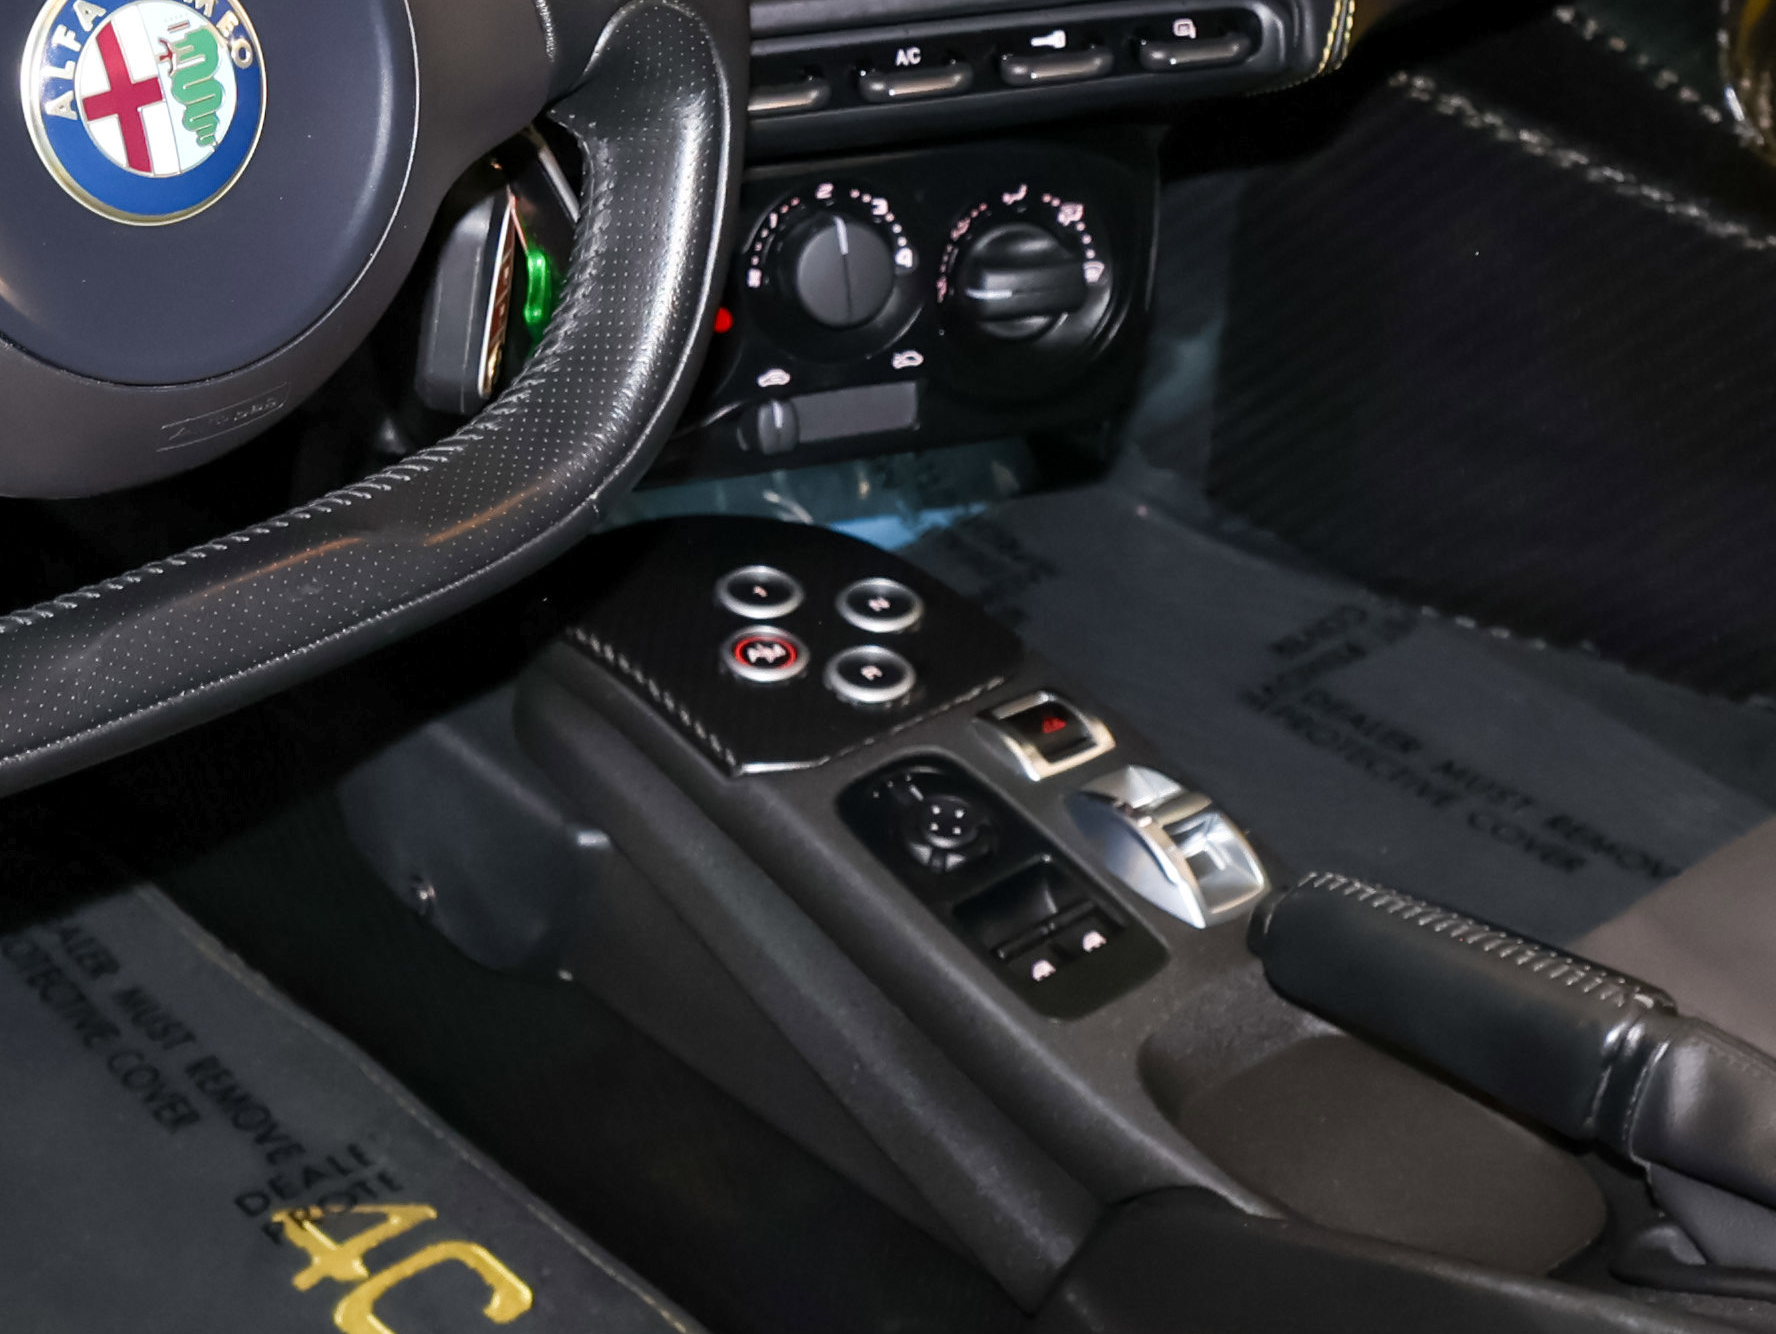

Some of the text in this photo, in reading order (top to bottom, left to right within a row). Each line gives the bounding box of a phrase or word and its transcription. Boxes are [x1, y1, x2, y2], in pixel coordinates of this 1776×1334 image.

[44, 0, 107, 121] ALFA
[104, 1045, 202, 1135] COVER
[182, 1054, 306, 1169] REMOVE
[234, 1133, 374, 1220] DEALE
